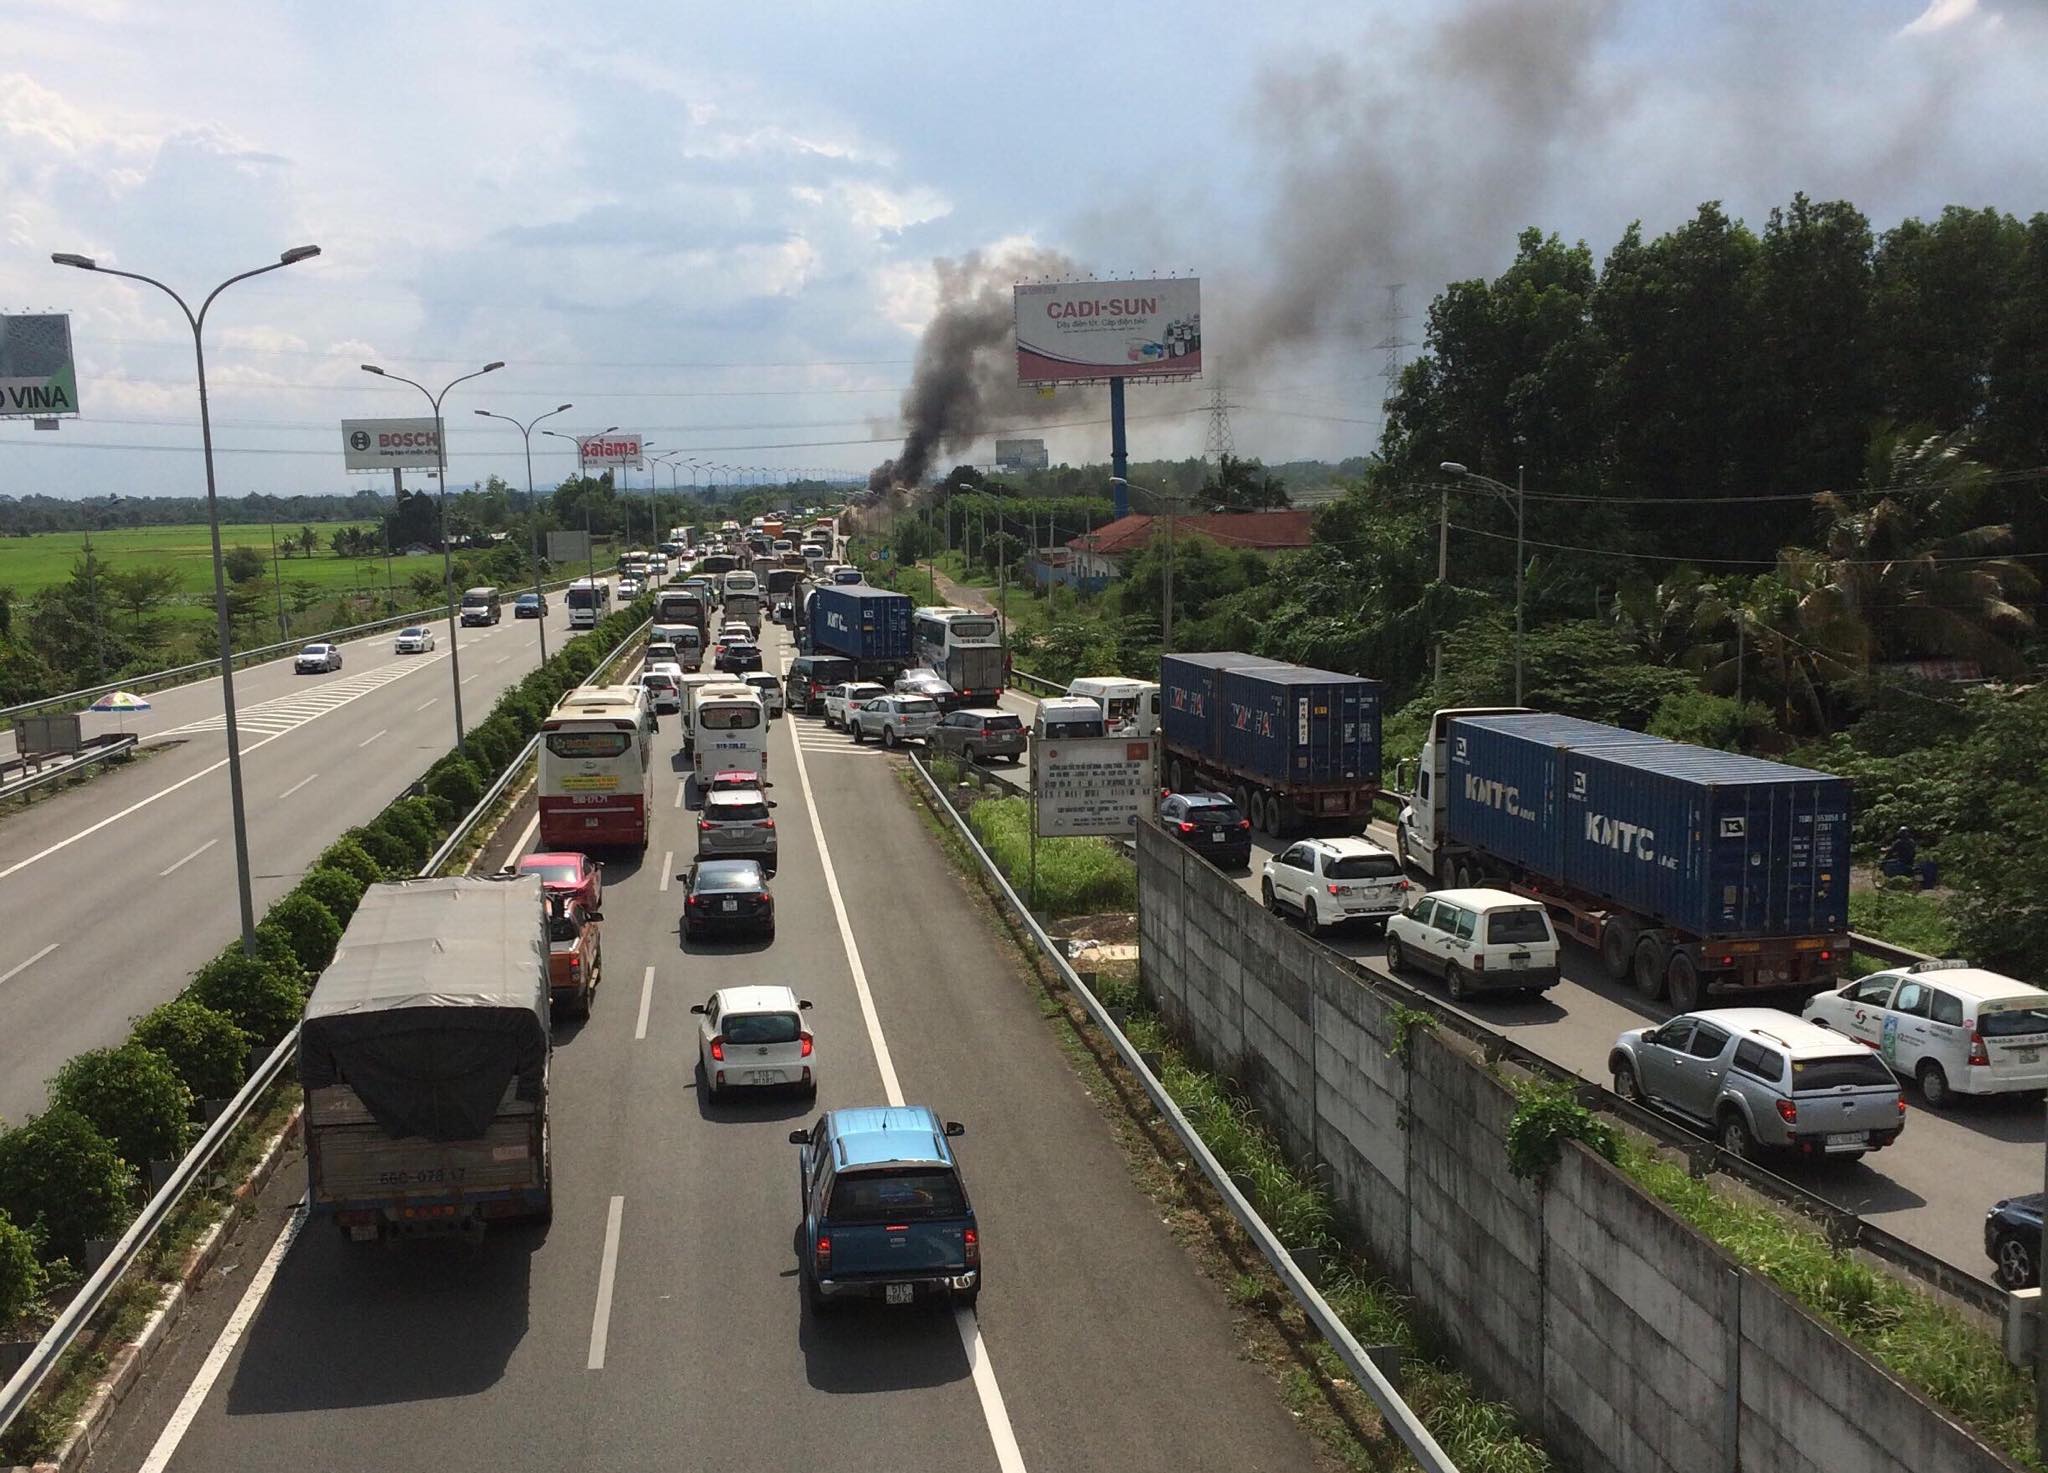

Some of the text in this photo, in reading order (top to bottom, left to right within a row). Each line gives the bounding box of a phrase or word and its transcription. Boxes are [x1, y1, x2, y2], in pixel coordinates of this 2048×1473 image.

[1047, 298, 1157, 319] CADI-SUN
[8, 385, 69, 408] VINA
[379, 431, 439, 447] BOSCH
[1466, 773, 1519, 816] KMTC
[1586, 812, 1655, 861] KMTC
